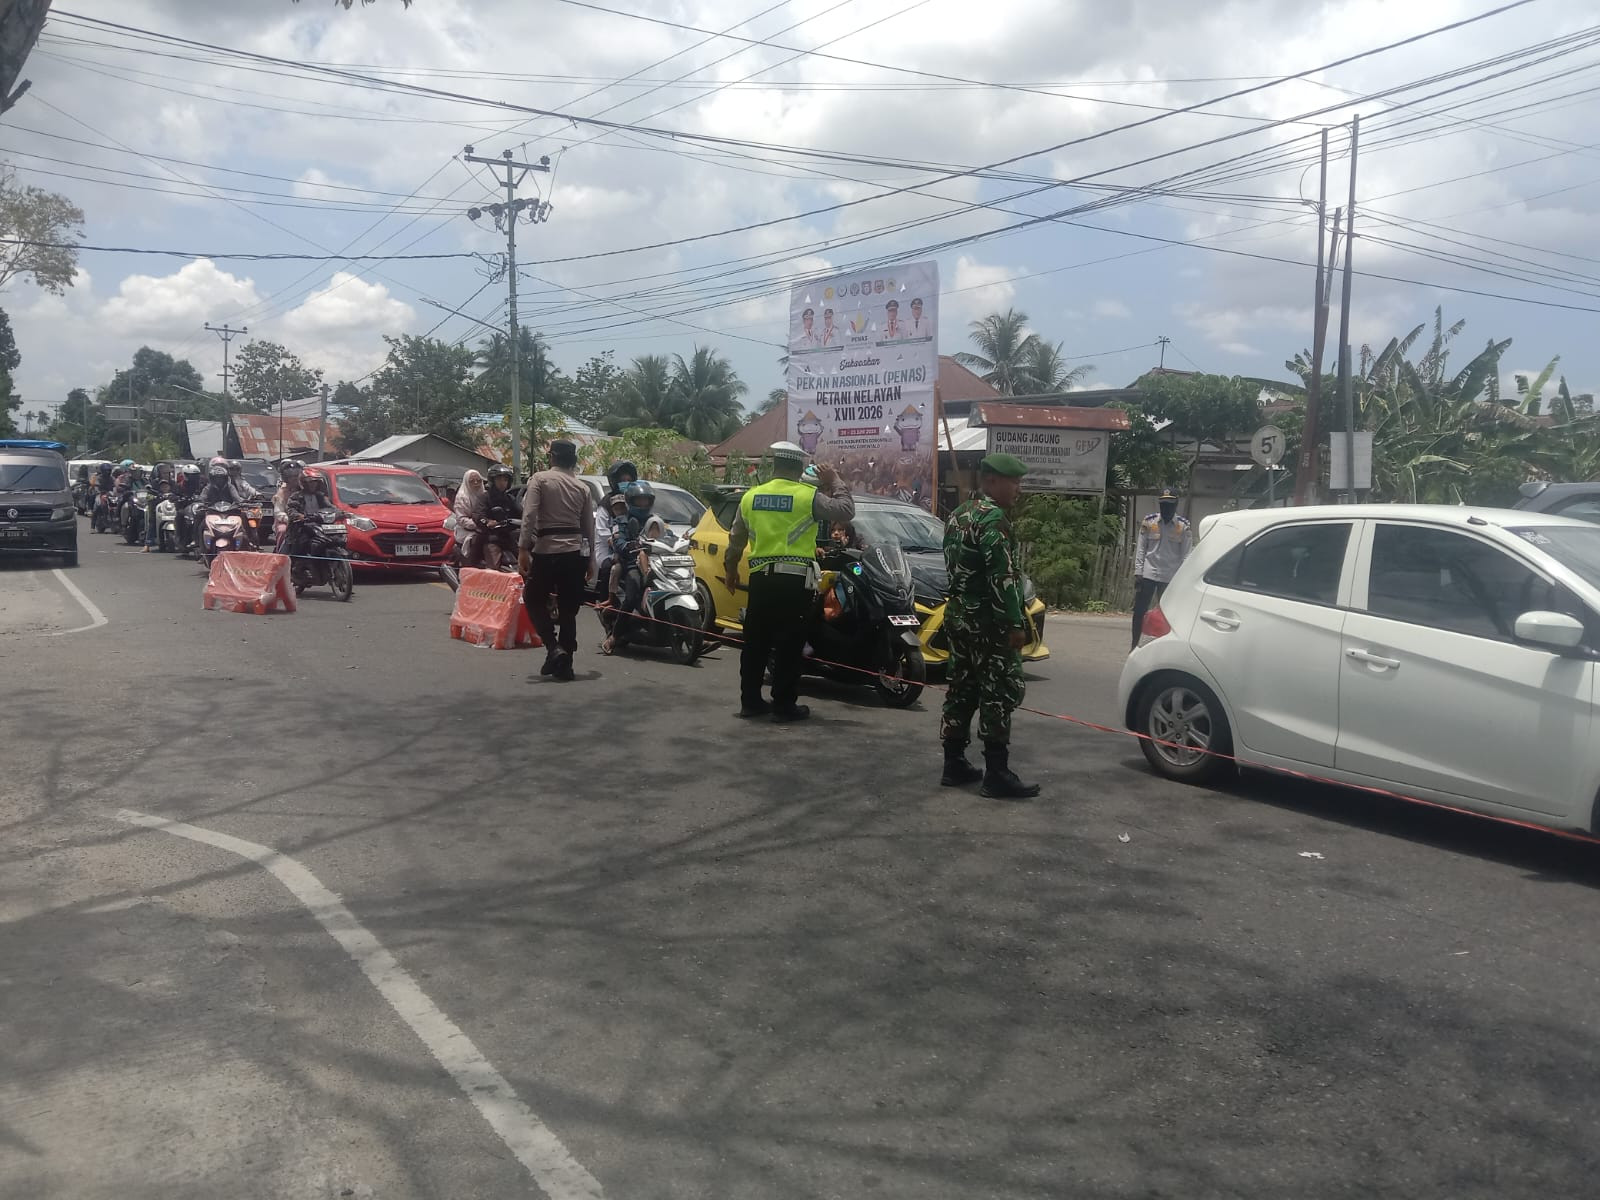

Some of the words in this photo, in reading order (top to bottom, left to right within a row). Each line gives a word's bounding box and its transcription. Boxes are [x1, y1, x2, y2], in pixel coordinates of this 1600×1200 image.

[851, 335, 868, 343] PENAS
[796, 376, 830, 390] PEKAN
[832, 373, 881, 389] NASIONAL
[883, 365, 927, 385] (PENAS)
[816, 391, 851, 406] PETANI
[853, 385, 902, 404] NELAYAN
[834, 407, 856, 421] XVII
[857, 405, 883, 420] 2026
[996, 431, 1028, 443] GUDANG
[1029, 433, 1060, 444] JAGUNG
[754, 495, 792, 510] POLISI
